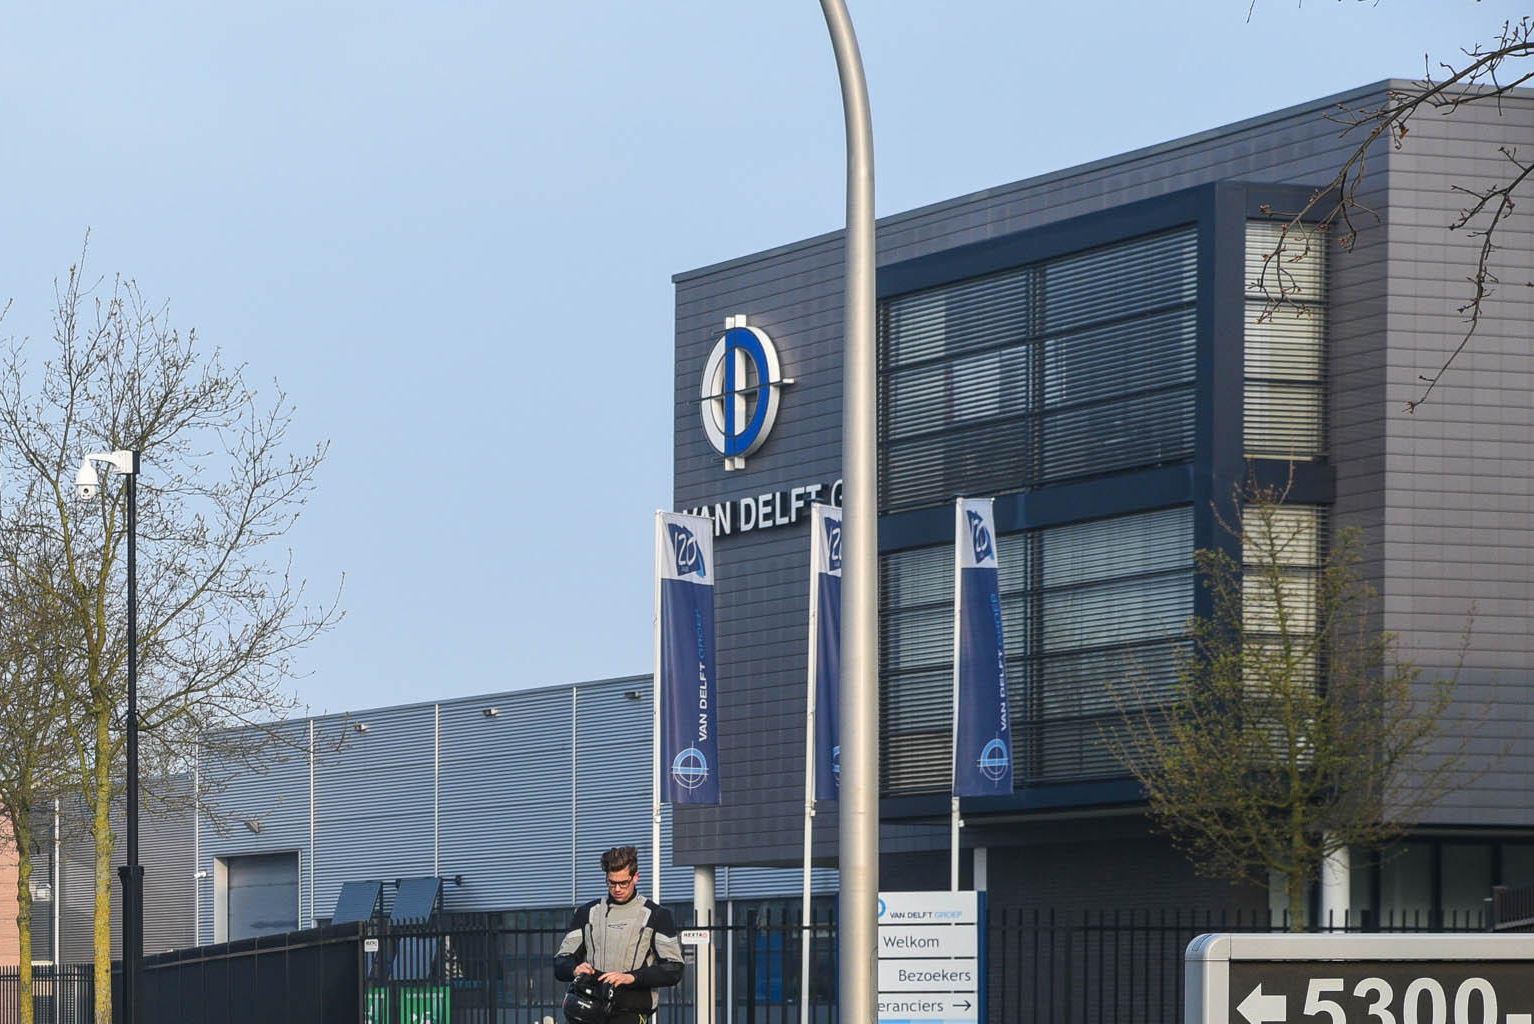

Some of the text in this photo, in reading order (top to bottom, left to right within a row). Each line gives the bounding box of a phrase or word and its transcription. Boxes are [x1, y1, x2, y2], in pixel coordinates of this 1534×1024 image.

[740, 484, 822, 533] DELFT
[699, 662, 708, 709] DELFT
[698, 713, 708, 742] VAN
[889, 911, 905, 919] VAN
[907, 911, 932, 919] DELFT
[883, 935, 940, 948] Welkom
[898, 969, 971, 982] Bezoekers
